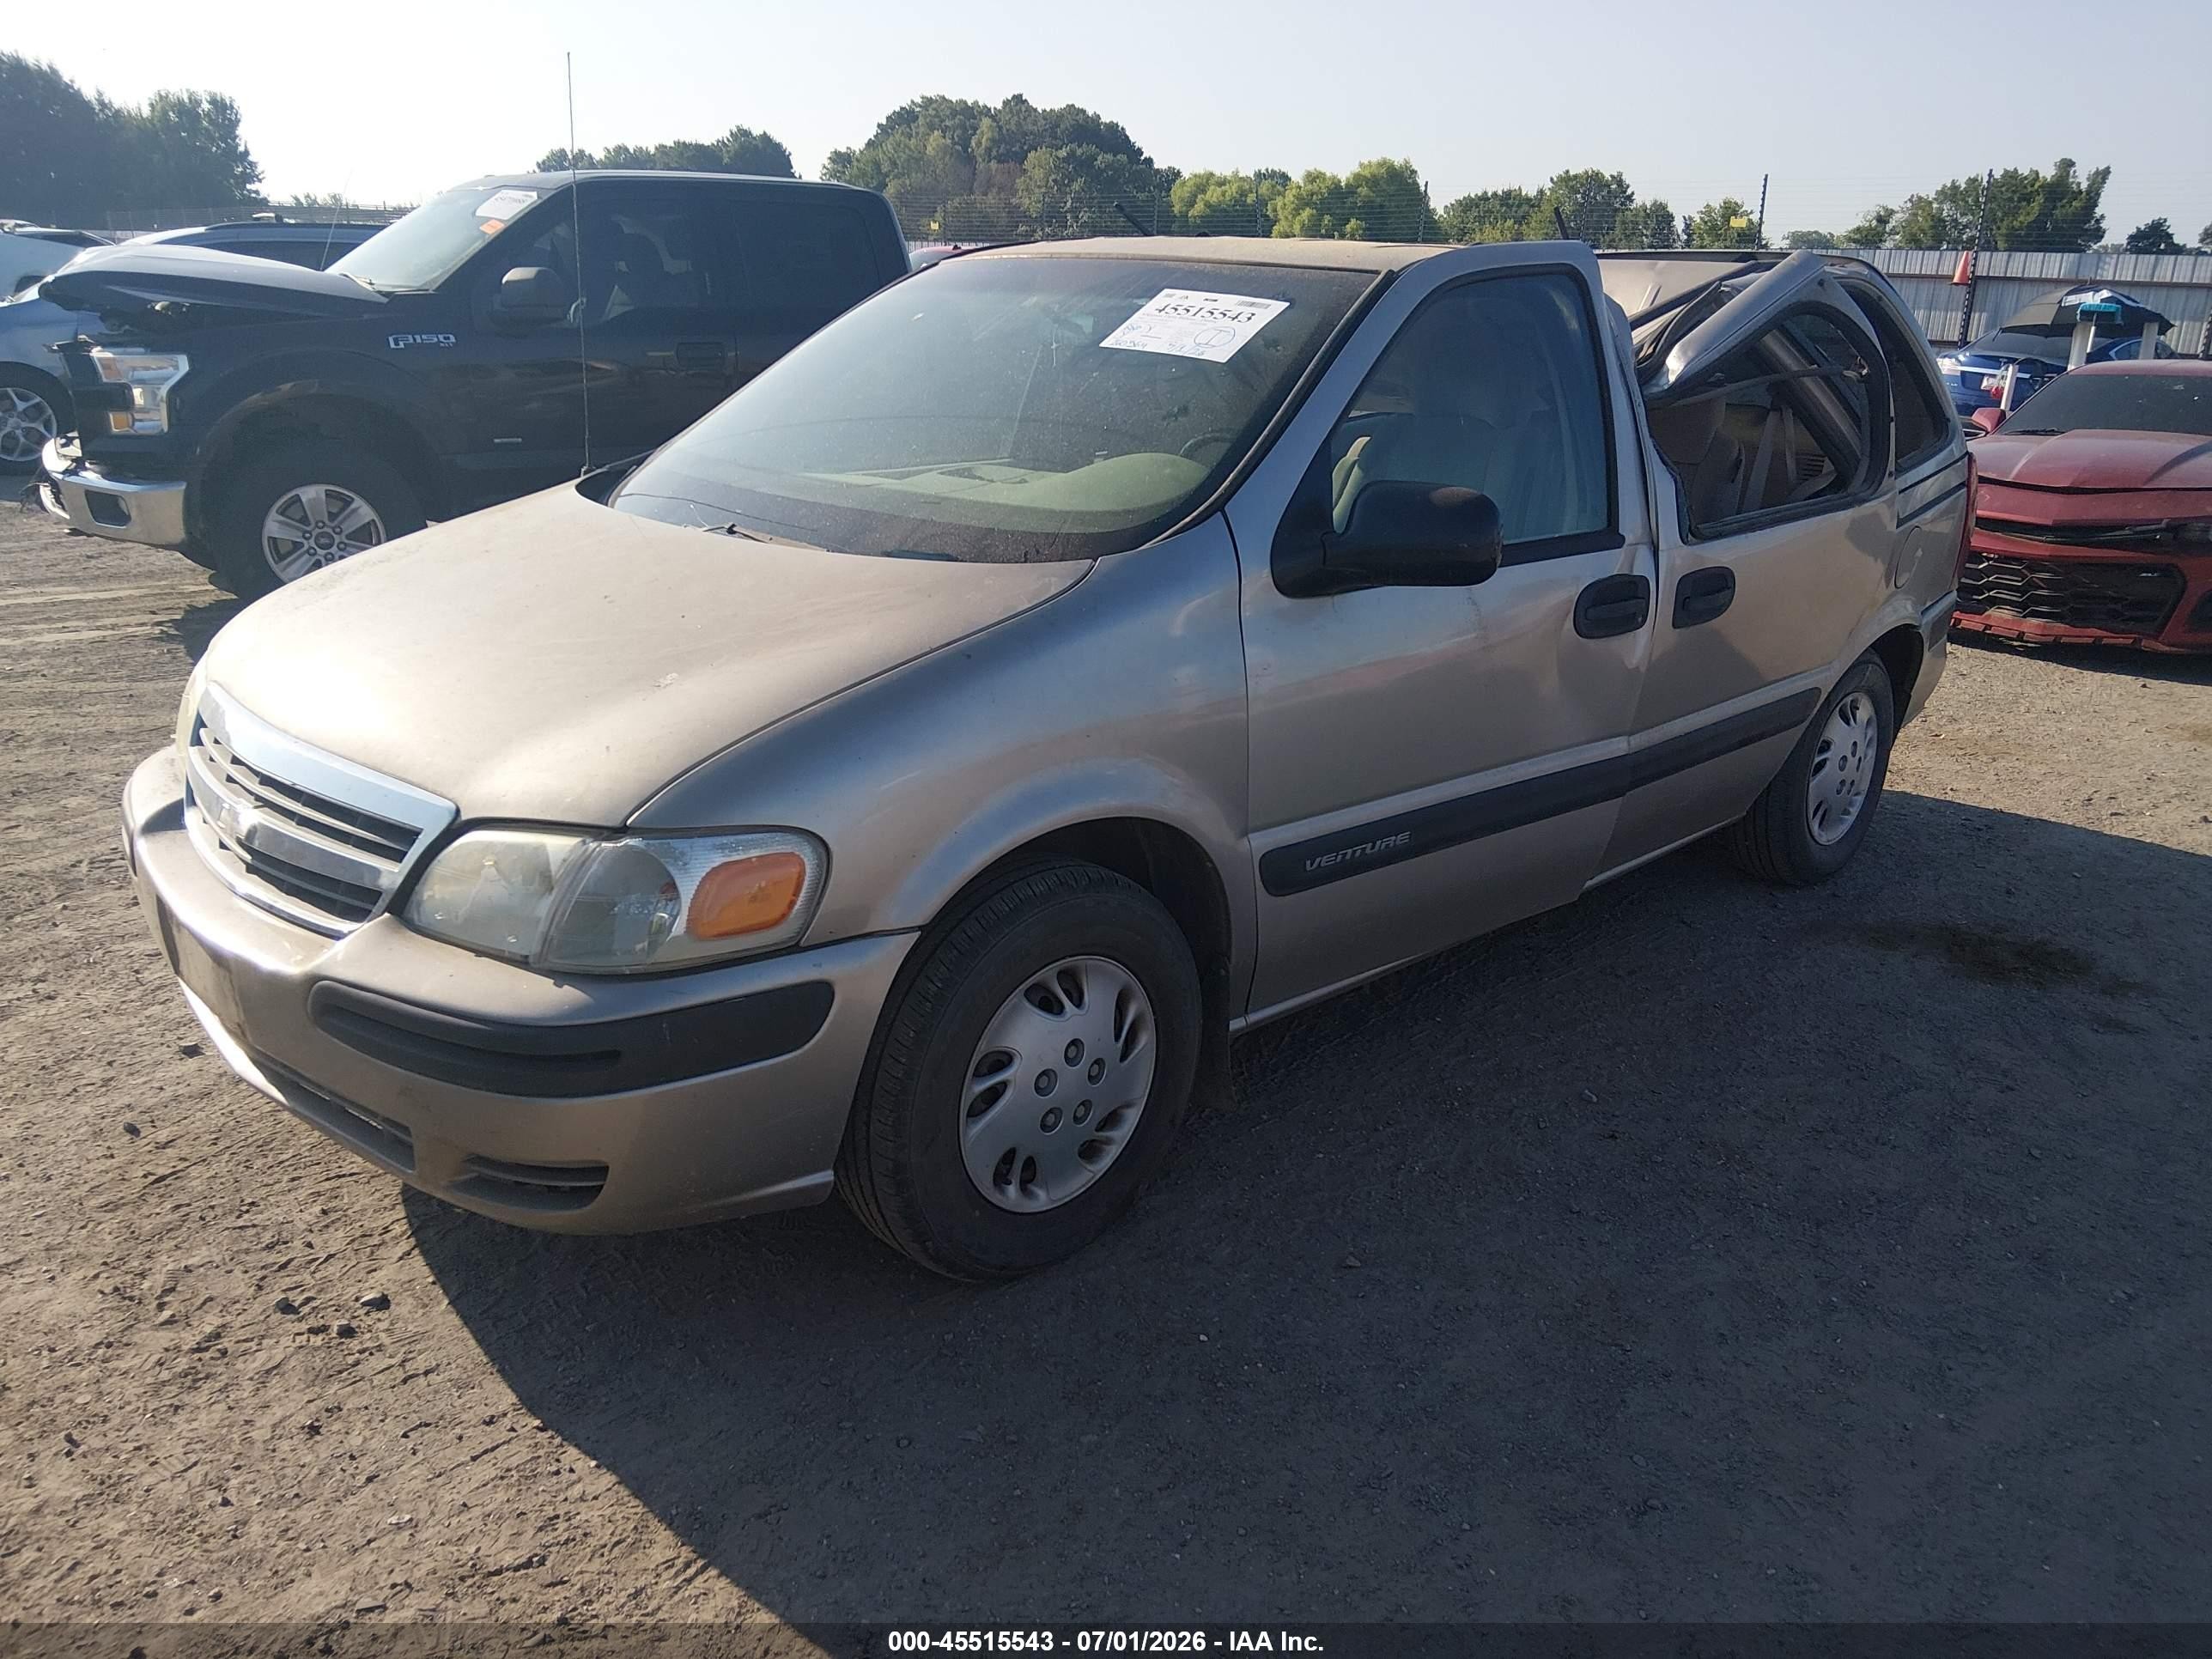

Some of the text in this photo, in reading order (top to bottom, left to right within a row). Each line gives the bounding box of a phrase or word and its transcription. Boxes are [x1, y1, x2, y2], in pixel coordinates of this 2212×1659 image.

[1155, 303, 1256, 324] 45515543
[388, 333, 457, 349] F150
[1305, 830, 1411, 872] VENTURE
